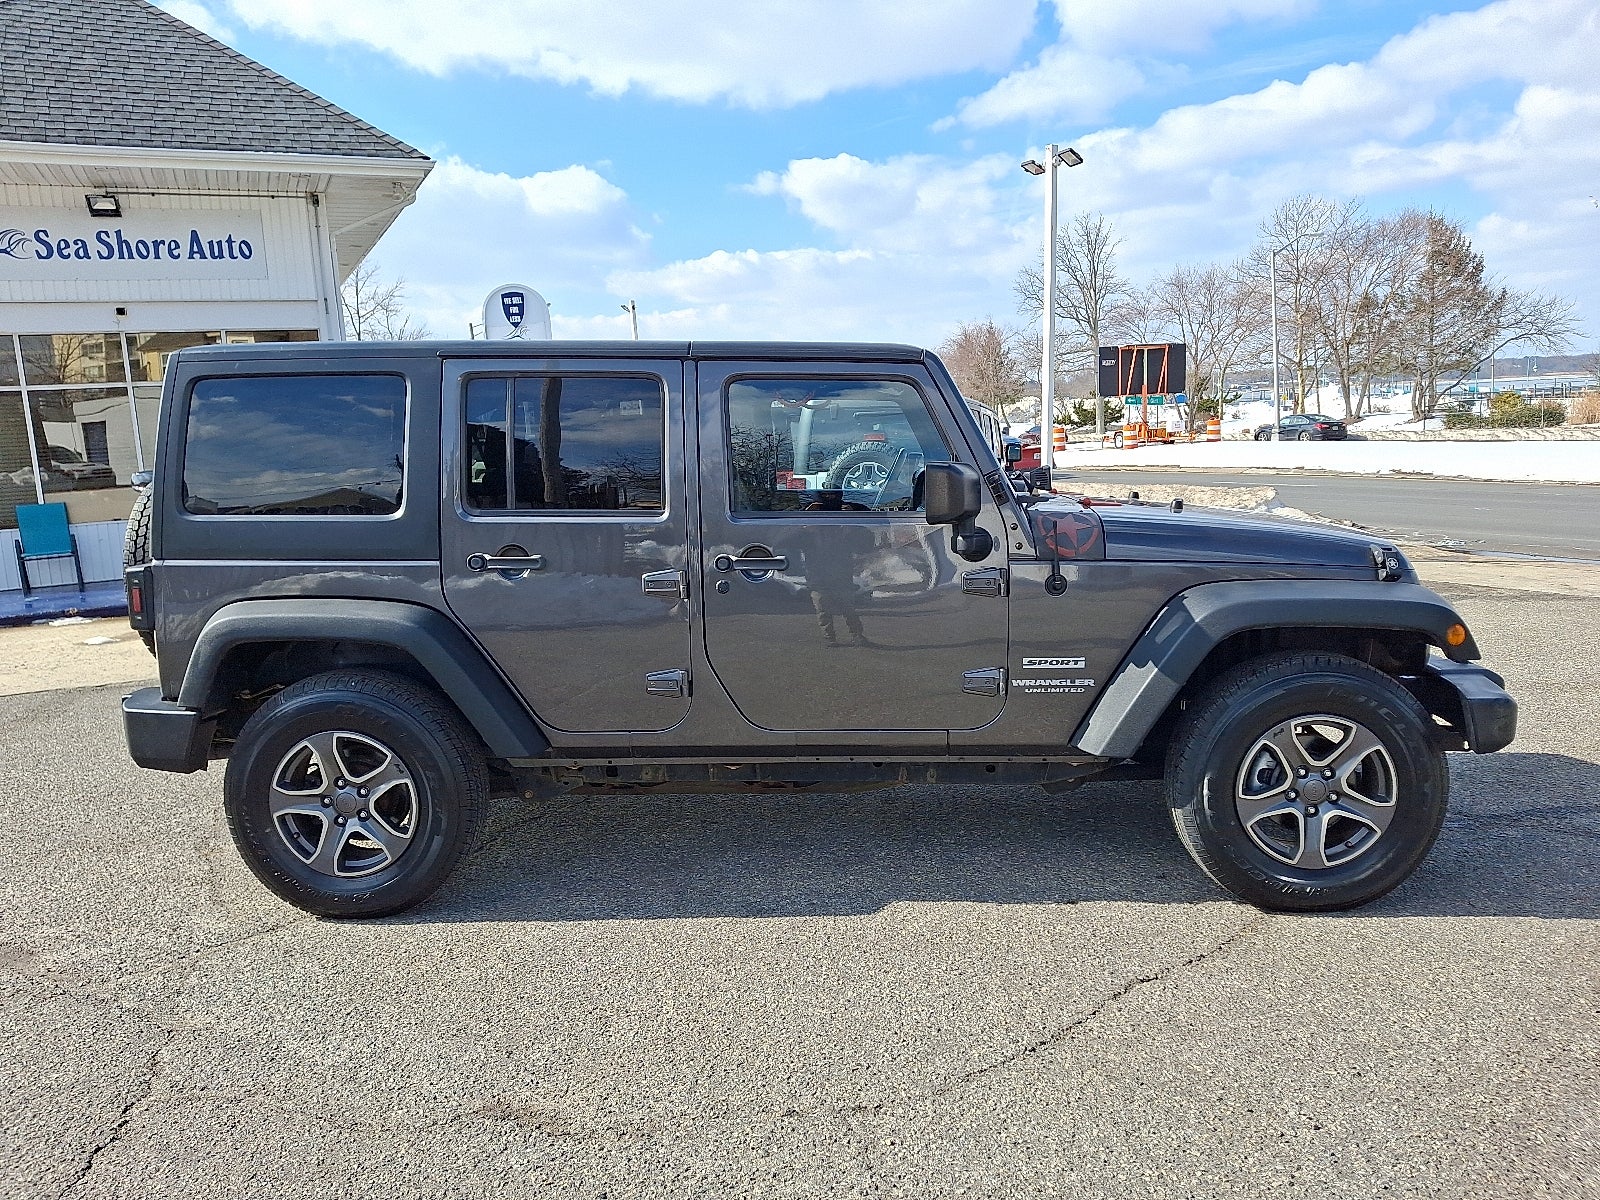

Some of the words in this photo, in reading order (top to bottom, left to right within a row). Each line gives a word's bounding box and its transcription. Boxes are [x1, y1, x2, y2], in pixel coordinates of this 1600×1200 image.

[33, 229, 91, 260] Sea
[95, 229, 181, 260] Shore
[187, 229, 253, 260] Auto
[1023, 658, 1085, 668] SPORT
[1011, 679, 1095, 687] WRANGLER
